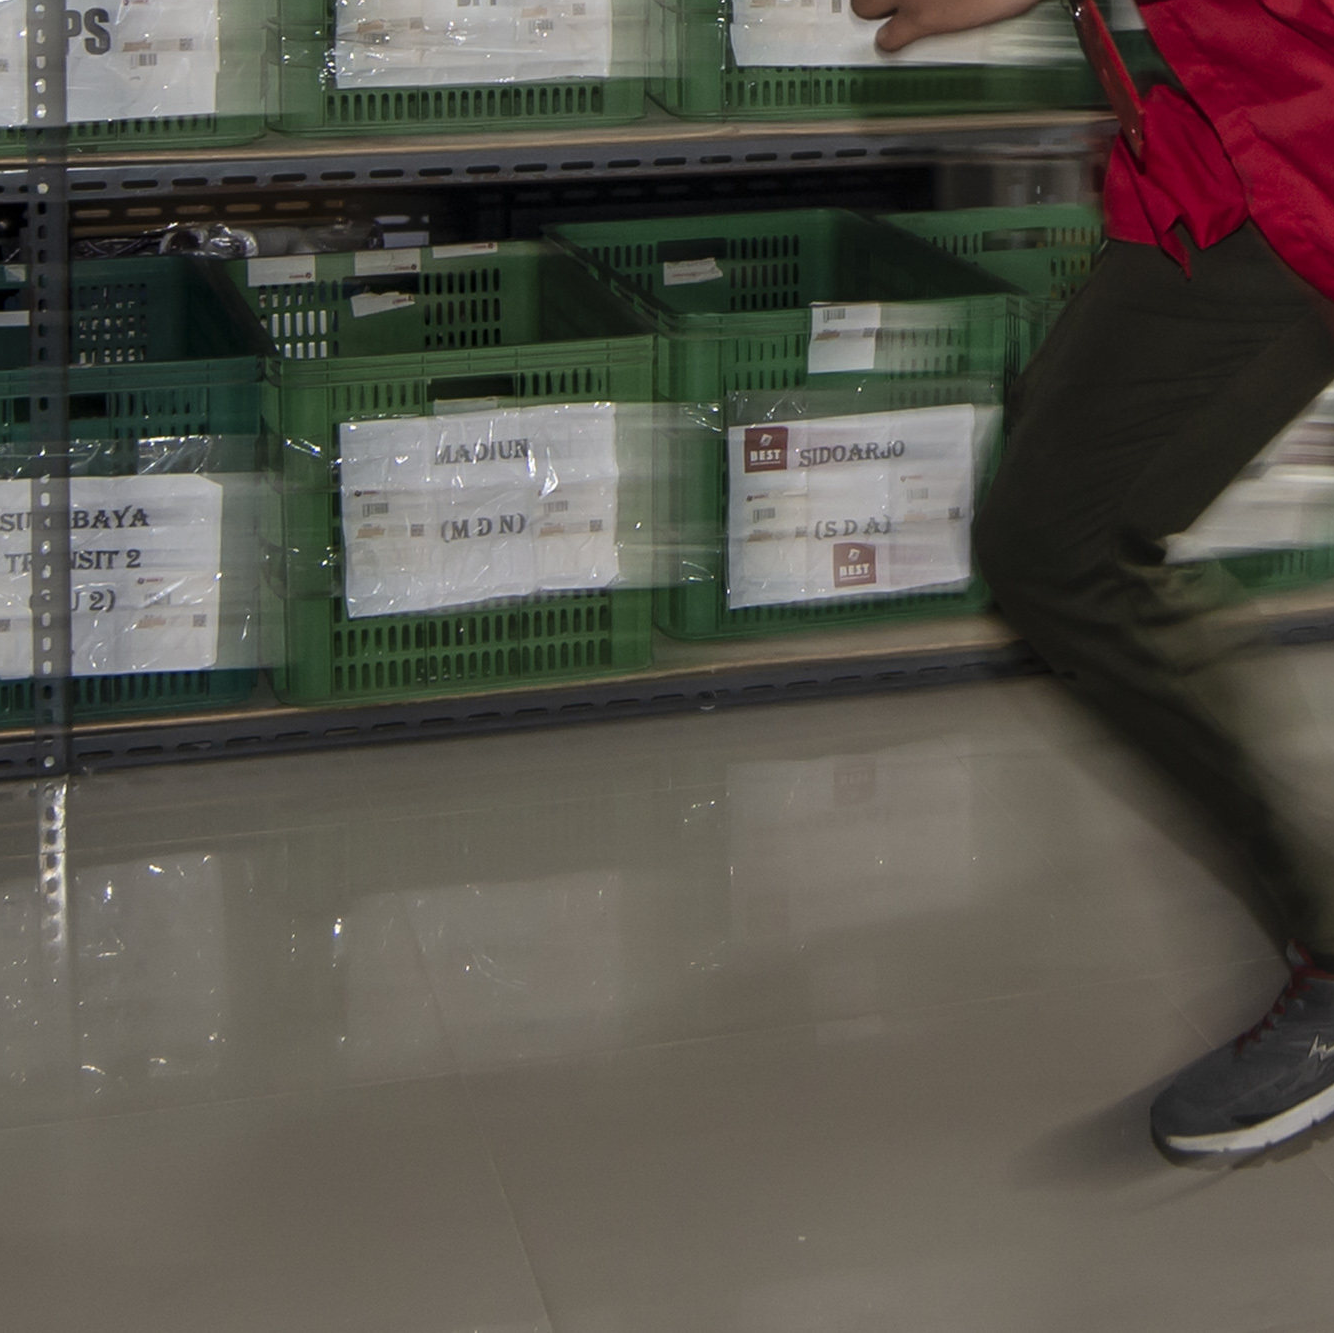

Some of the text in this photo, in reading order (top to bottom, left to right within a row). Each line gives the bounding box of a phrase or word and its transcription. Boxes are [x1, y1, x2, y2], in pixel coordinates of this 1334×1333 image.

[66, 6, 112, 57] PS
[434, 437, 532, 466] MADIUN
[749, 448, 781, 464] BEST
[798, 439, 906, 468] SIDOARJO
[0, 505, 151, 534] SUBAYA
[4, 548, 143, 574] TRSIT 2
[838, 562, 870, 578] BEST
